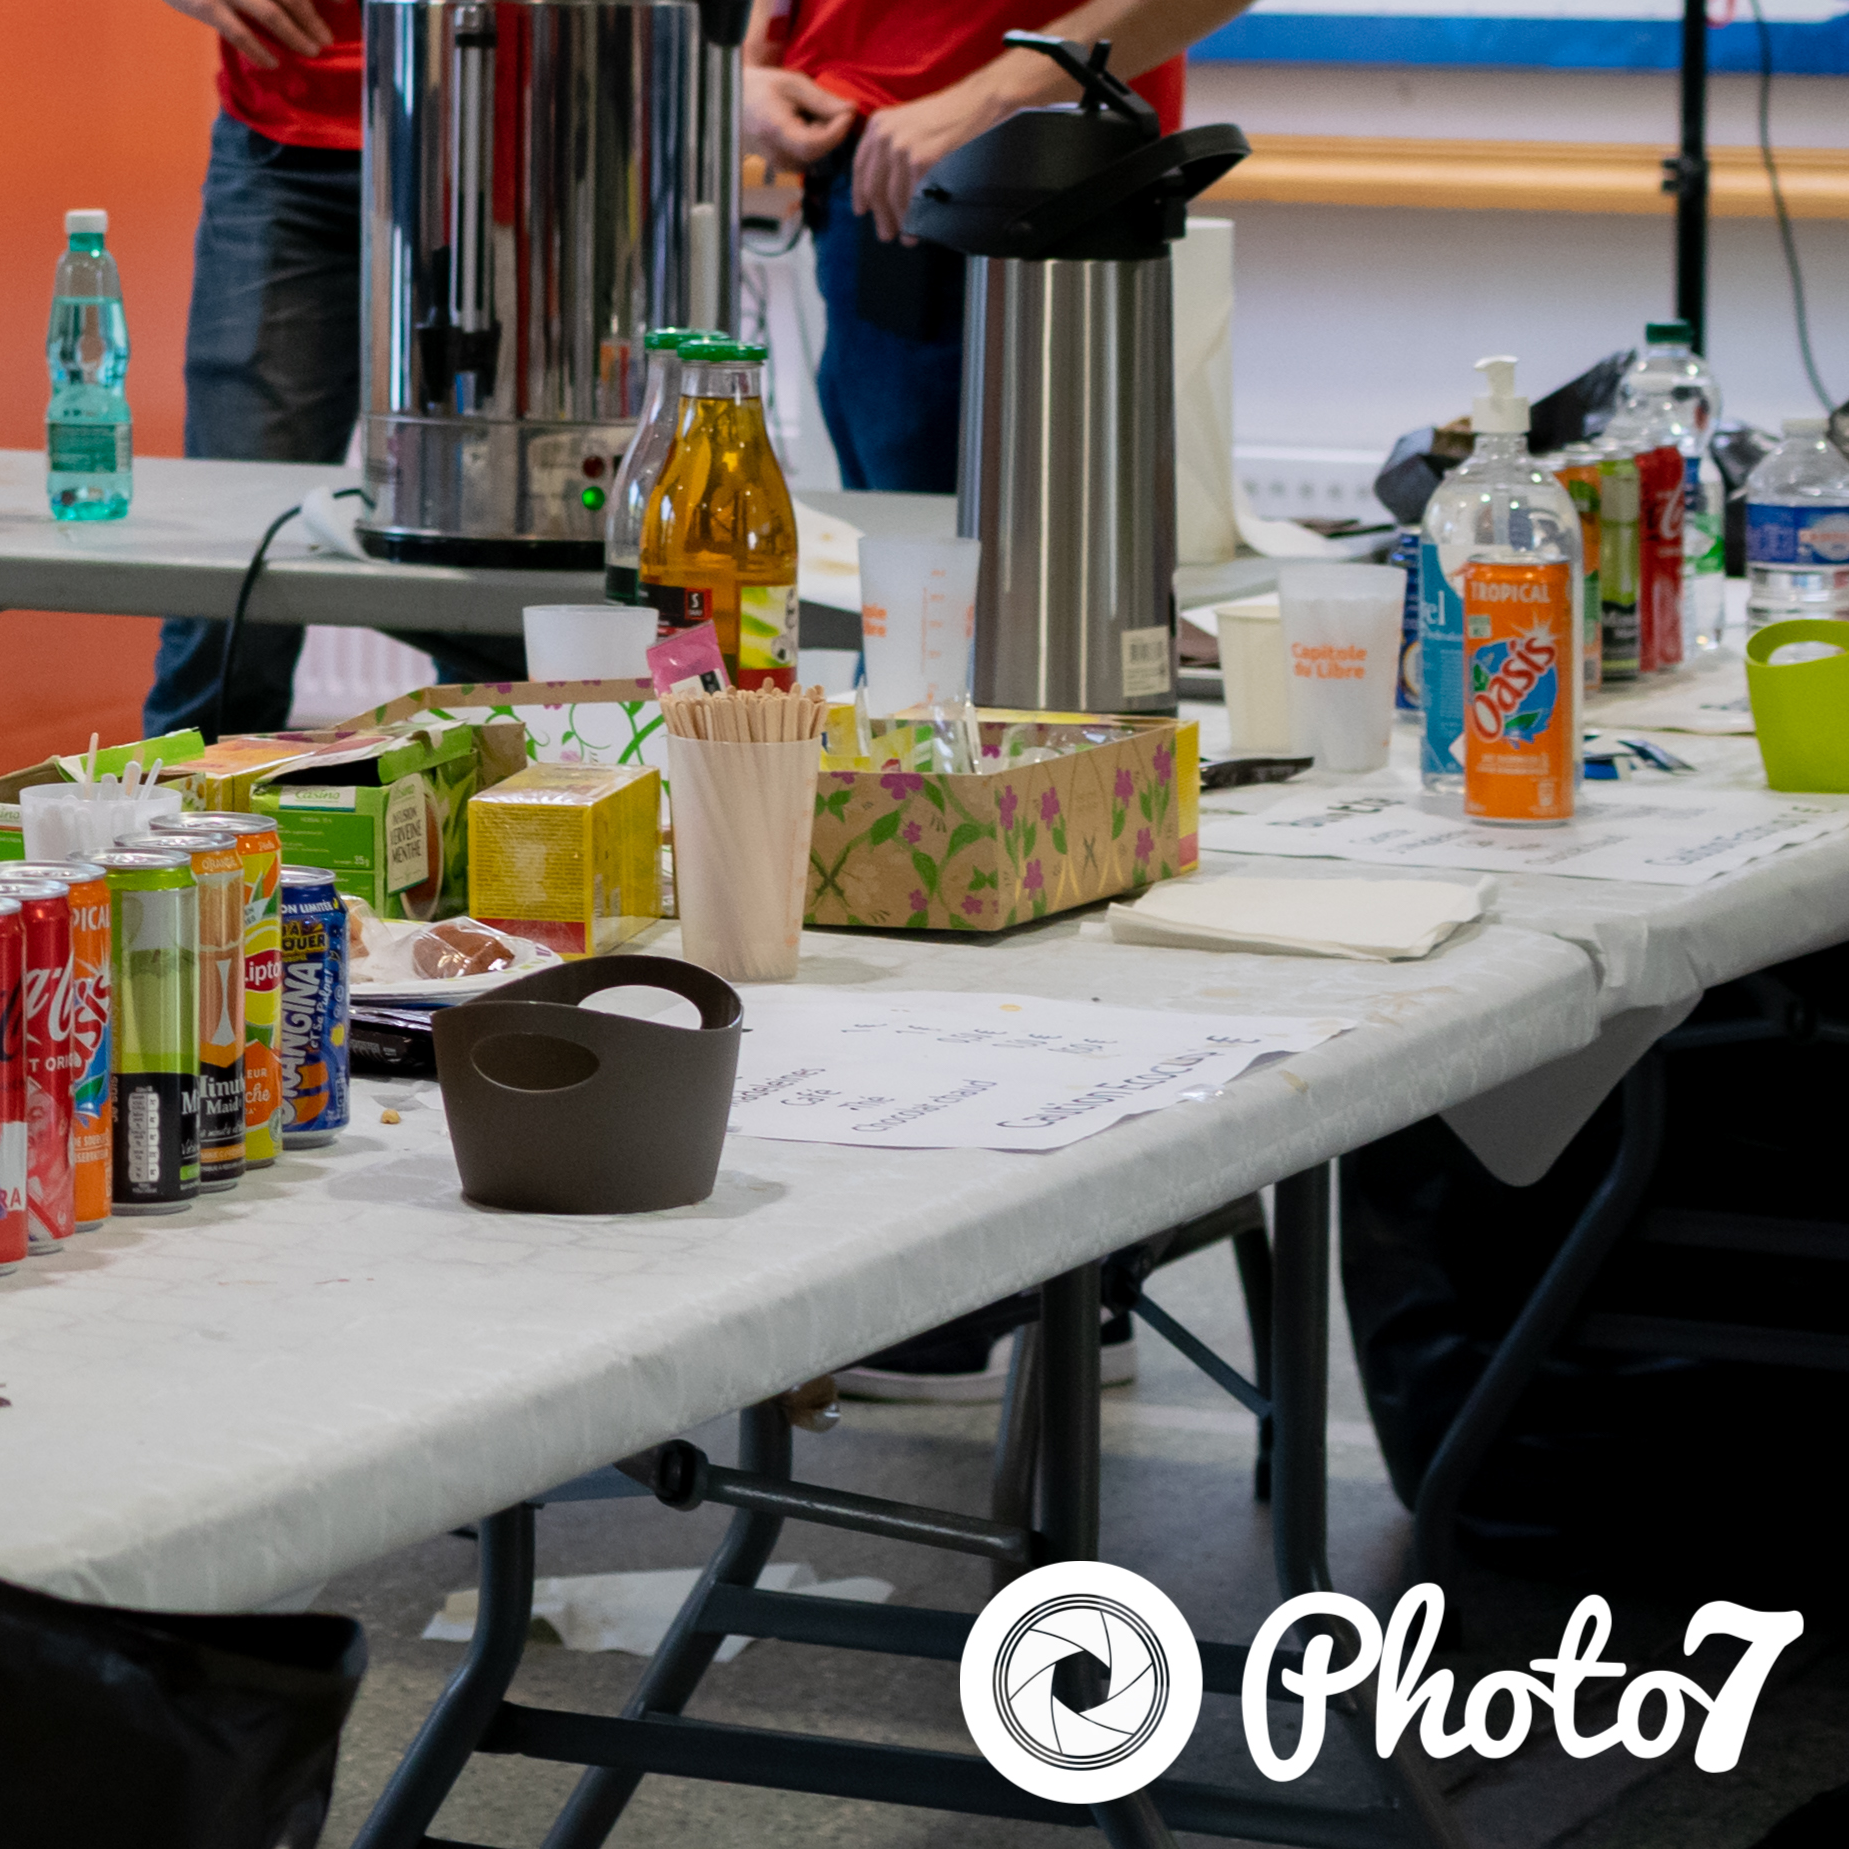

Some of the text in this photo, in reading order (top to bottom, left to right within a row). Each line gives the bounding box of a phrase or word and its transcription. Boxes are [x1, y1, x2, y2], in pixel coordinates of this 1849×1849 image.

[1471, 581, 1551, 604] TROPICAL
[1471, 636, 1556, 742] Oasis
[244, 957, 282, 986] ipto
[730, 1067, 827, 1108] adeleines
[780, 1086, 842, 1107] Café
[206, 1095, 240, 1116] Maid
[995, 1090, 1134, 1129] Caution
